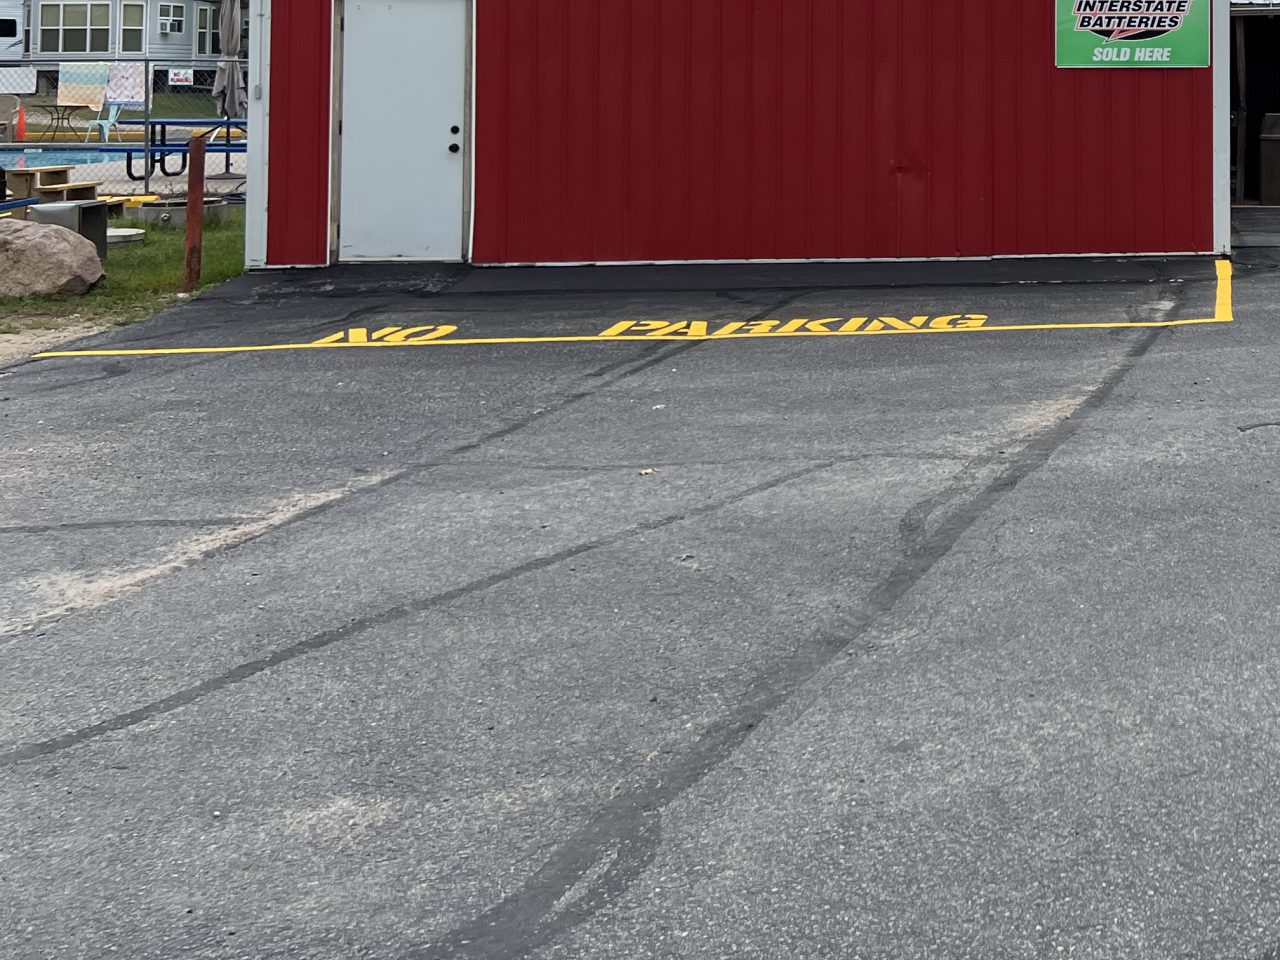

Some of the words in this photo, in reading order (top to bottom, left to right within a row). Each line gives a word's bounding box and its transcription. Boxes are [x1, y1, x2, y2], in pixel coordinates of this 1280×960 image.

[1076, 0, 1188, 13] INTERSTATE
[1079, 15, 1181, 28] BATTERIES
[1093, 47, 1130, 61] SOLD
[1134, 47, 1172, 61] HERE
[312, 324, 458, 343] NO
[599, 314, 989, 337] PARKING
